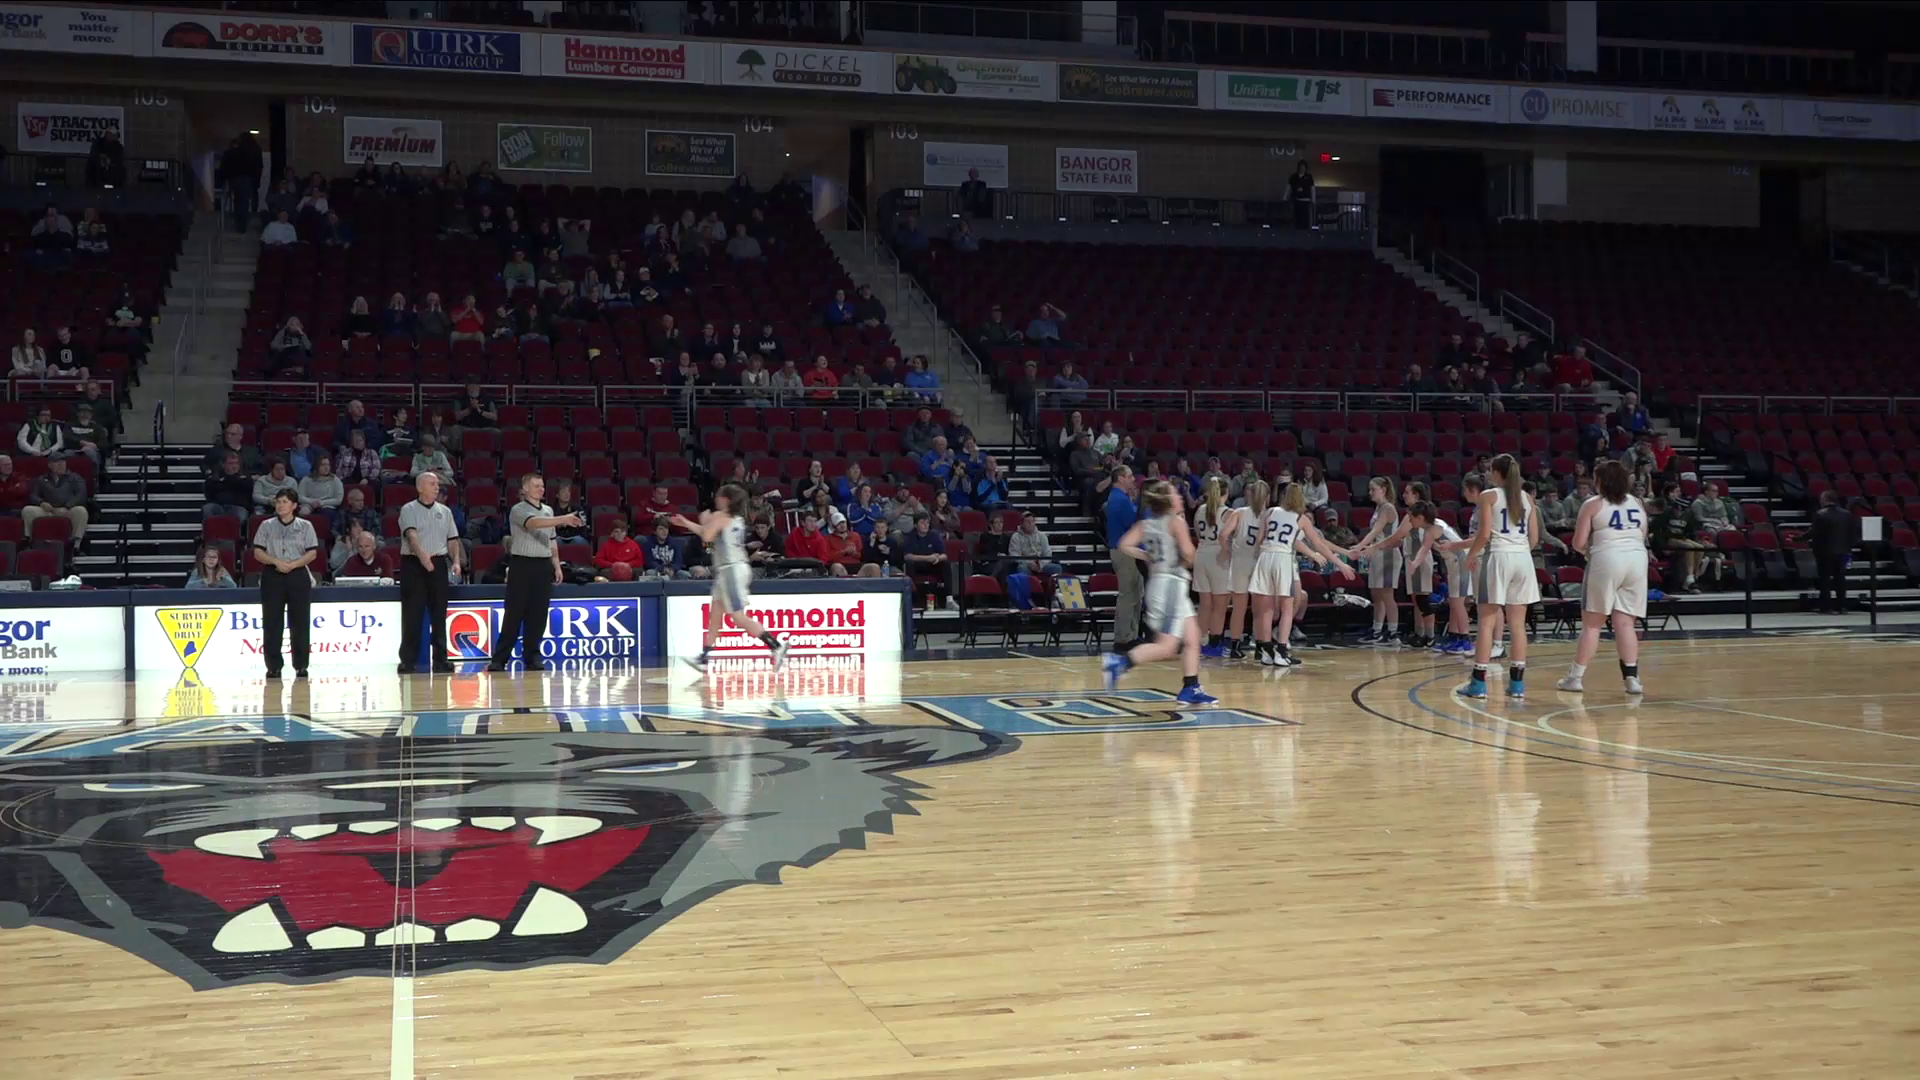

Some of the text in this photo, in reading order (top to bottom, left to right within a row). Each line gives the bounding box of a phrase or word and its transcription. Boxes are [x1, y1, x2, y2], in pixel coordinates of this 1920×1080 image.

[80, 11, 107, 22] You
[68, 22, 120, 33] matter
[220, 21, 323, 44] DORR'S
[73, 33, 115, 43] more.
[225, 41, 322, 54] EQUIPMENT
[564, 37, 685, 63] Hammond
[409, 52, 503, 70] AUTO GROUP
[567, 60, 682, 78] Lumber Company
[774, 51, 862, 73] DICKEL
[774, 71, 860, 85] Floor Supply
[1233, 83, 1281, 97] UniFirst
[1396, 90, 1491, 106] PERFORMANCE
[303, 95, 337, 114] 104
[1552, 98, 1625, 118] PROMISE
[50, 115, 120, 130] TRACTOR
[742, 116, 775, 133] 104
[349, 133, 436, 153] PREMIUM
[543, 131, 585, 148] Follow
[689, 136, 727, 146] See What
[1060, 155, 1132, 172] BANGOR
[1061, 172, 1133, 185] STATE FAIR
[1608, 509, 1641, 531] 45
[1198, 520, 1219, 541] 23
[1266, 520, 1293, 545] 22
[169, 612, 210, 621] SURVIVE
[338, 609, 383, 634] Up.
[177, 621, 203, 630] YOUR
[562, 637, 635, 658] GROUP
[776, 631, 861, 649] Company
[1, 643, 58, 660] Bank
